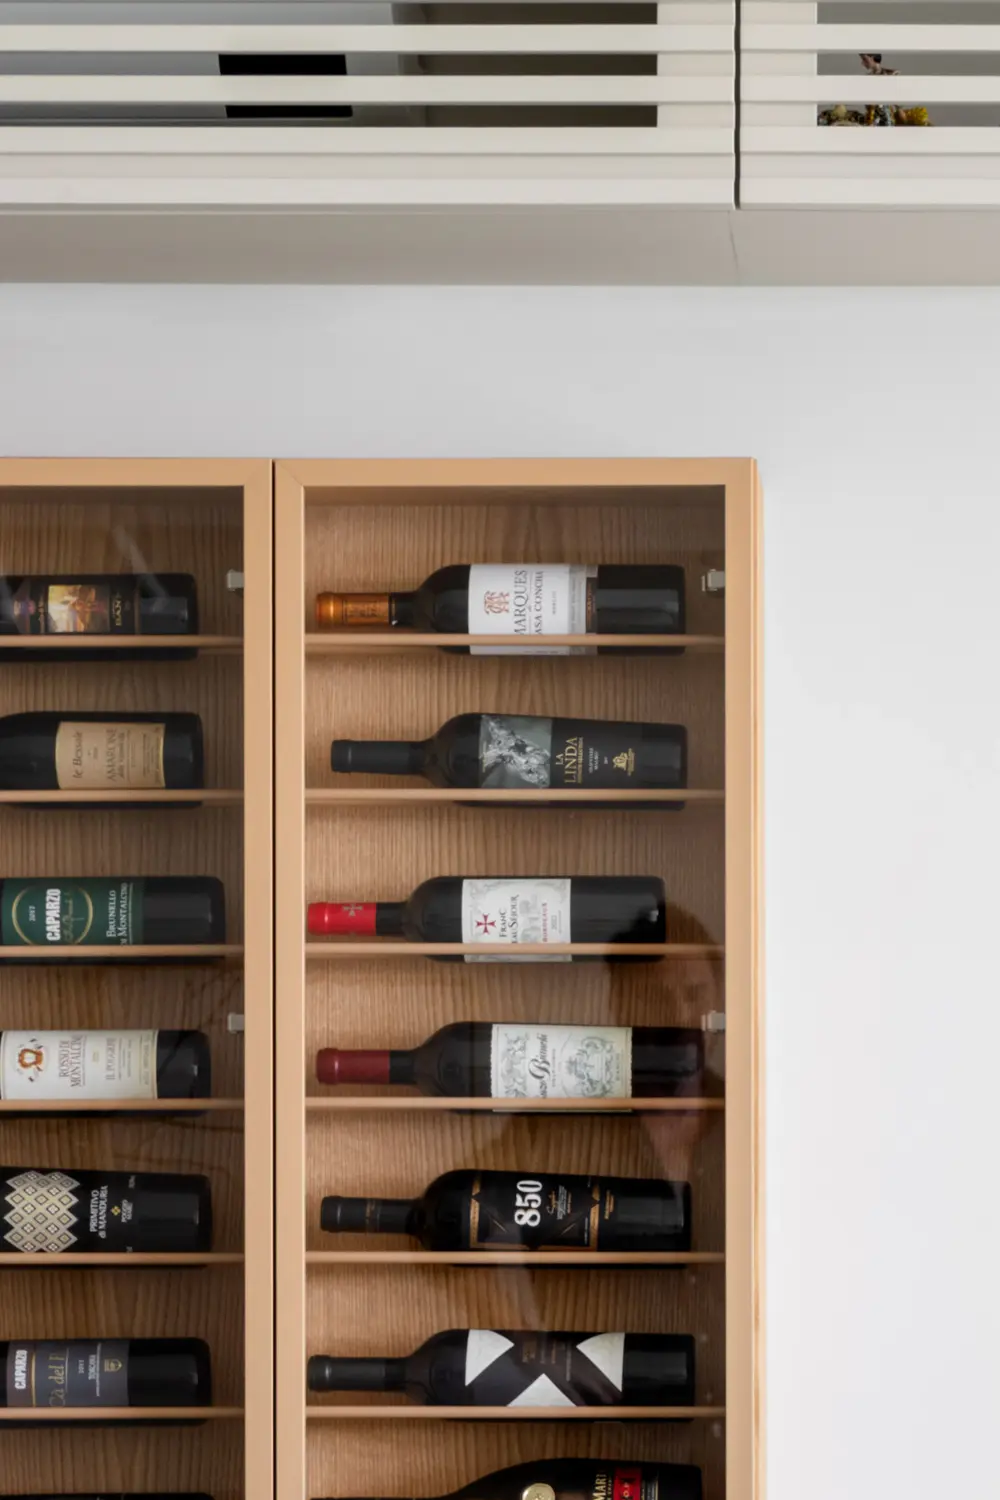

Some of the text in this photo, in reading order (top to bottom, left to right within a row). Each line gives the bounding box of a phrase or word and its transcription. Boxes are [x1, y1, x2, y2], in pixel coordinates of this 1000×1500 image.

[534, 615, 542, 635] ASA
[555, 753, 564, 766] LA
[564, 737, 577, 784] LINDA
[45, 888, 61, 941] CAPARZO
[106, 890, 117, 938] BRUNELLO
[499, 908, 507, 938] FRANC
[89, 1190, 99, 1233] PRIMITIVO
[98, 1185, 108, 1229] MANDURIA
[514, 1179, 543, 1227] 850
[15, 1350, 28, 1390] CAPARZO
